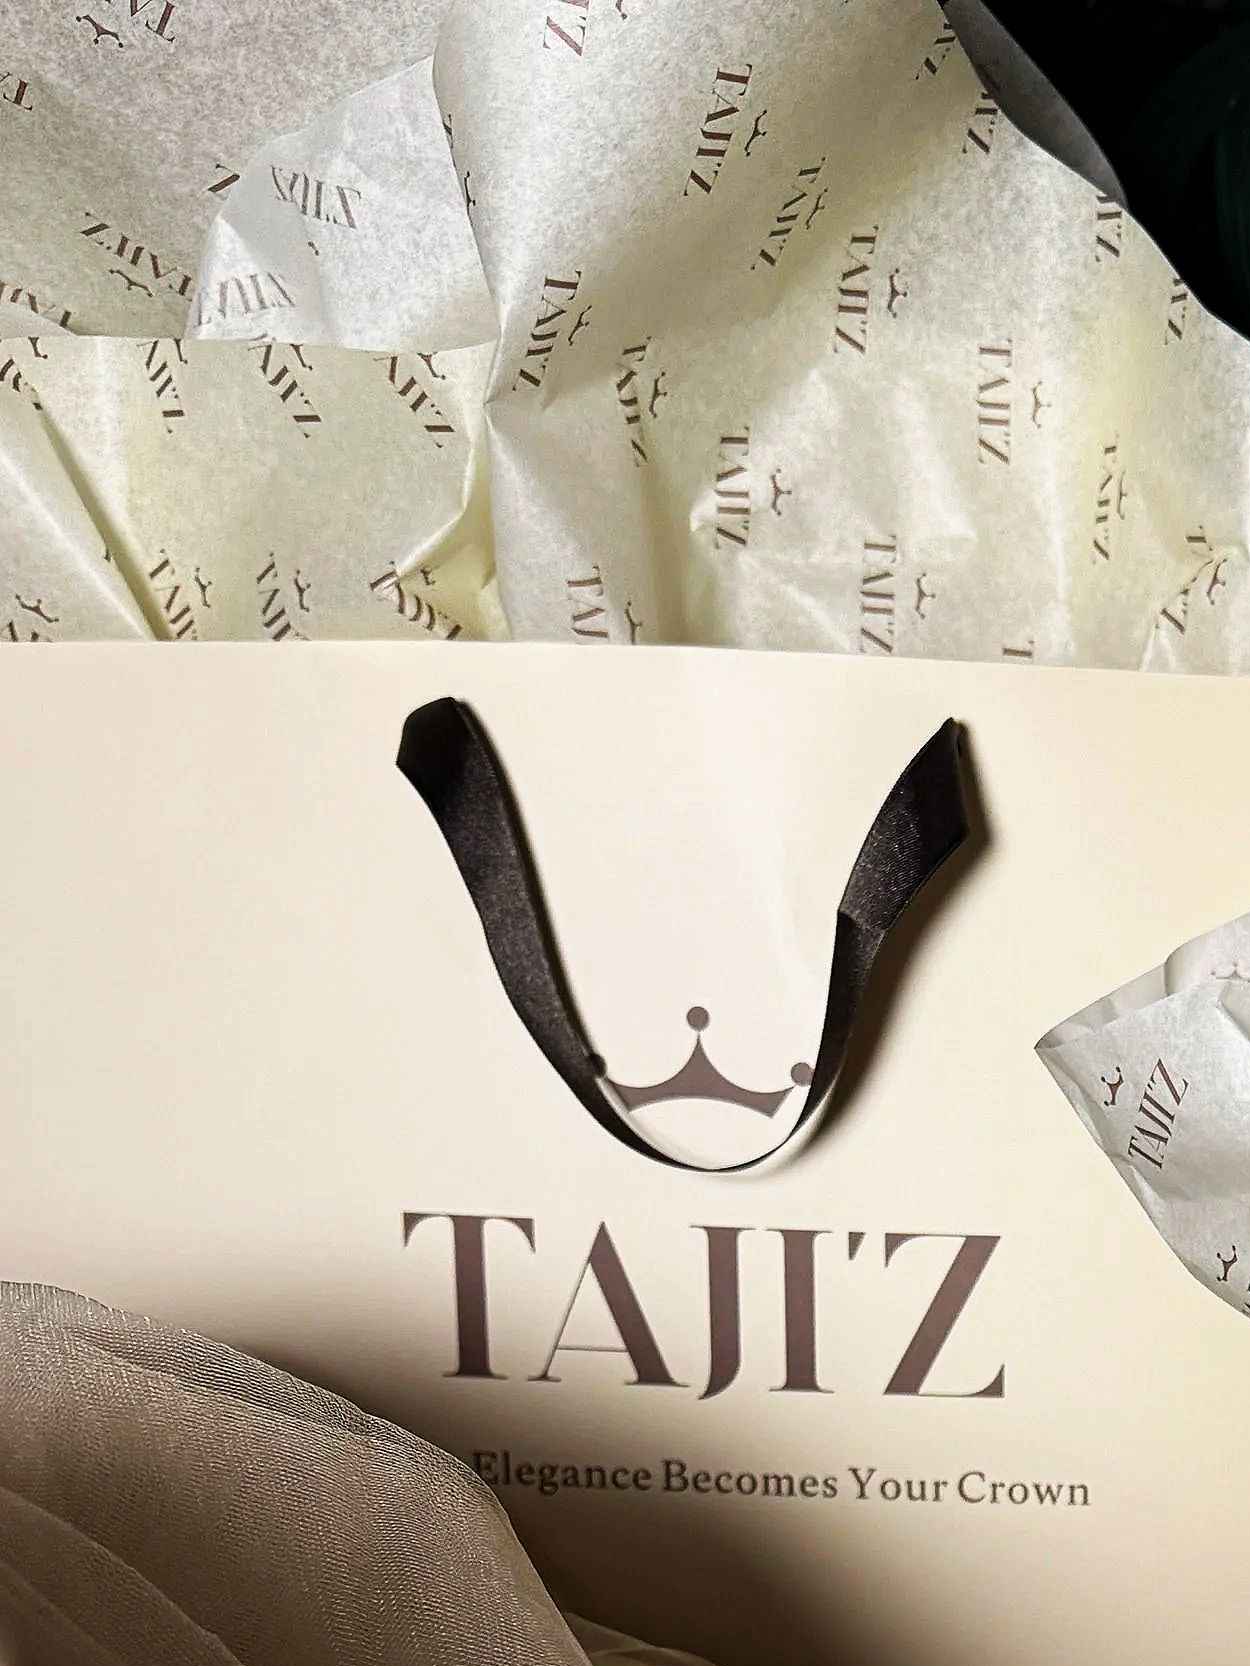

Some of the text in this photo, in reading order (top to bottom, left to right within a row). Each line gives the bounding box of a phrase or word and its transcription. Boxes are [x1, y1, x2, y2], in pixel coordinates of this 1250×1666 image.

[684, 63, 753, 197] TAJI'Z
[512, 270, 582, 392] TAJI'Z
[833, 225, 879, 354] TAJI'Z
[136, 339, 186, 434] AJI'Z
[248, 336, 323, 438] AJI'Z
[373, 354, 456, 449] AJI'Z
[976, 338, 1014, 466] TAJI'Z
[714, 426, 751, 550] TAJI'Z
[860, 534, 897, 655] TAJI'Z
[1127, 1058, 1190, 1170] TAJI'Z
[402, 1211, 1006, 1401] TAJI'Z
[472, 1451, 1092, 1508] Elegance Becomes Your Crown
